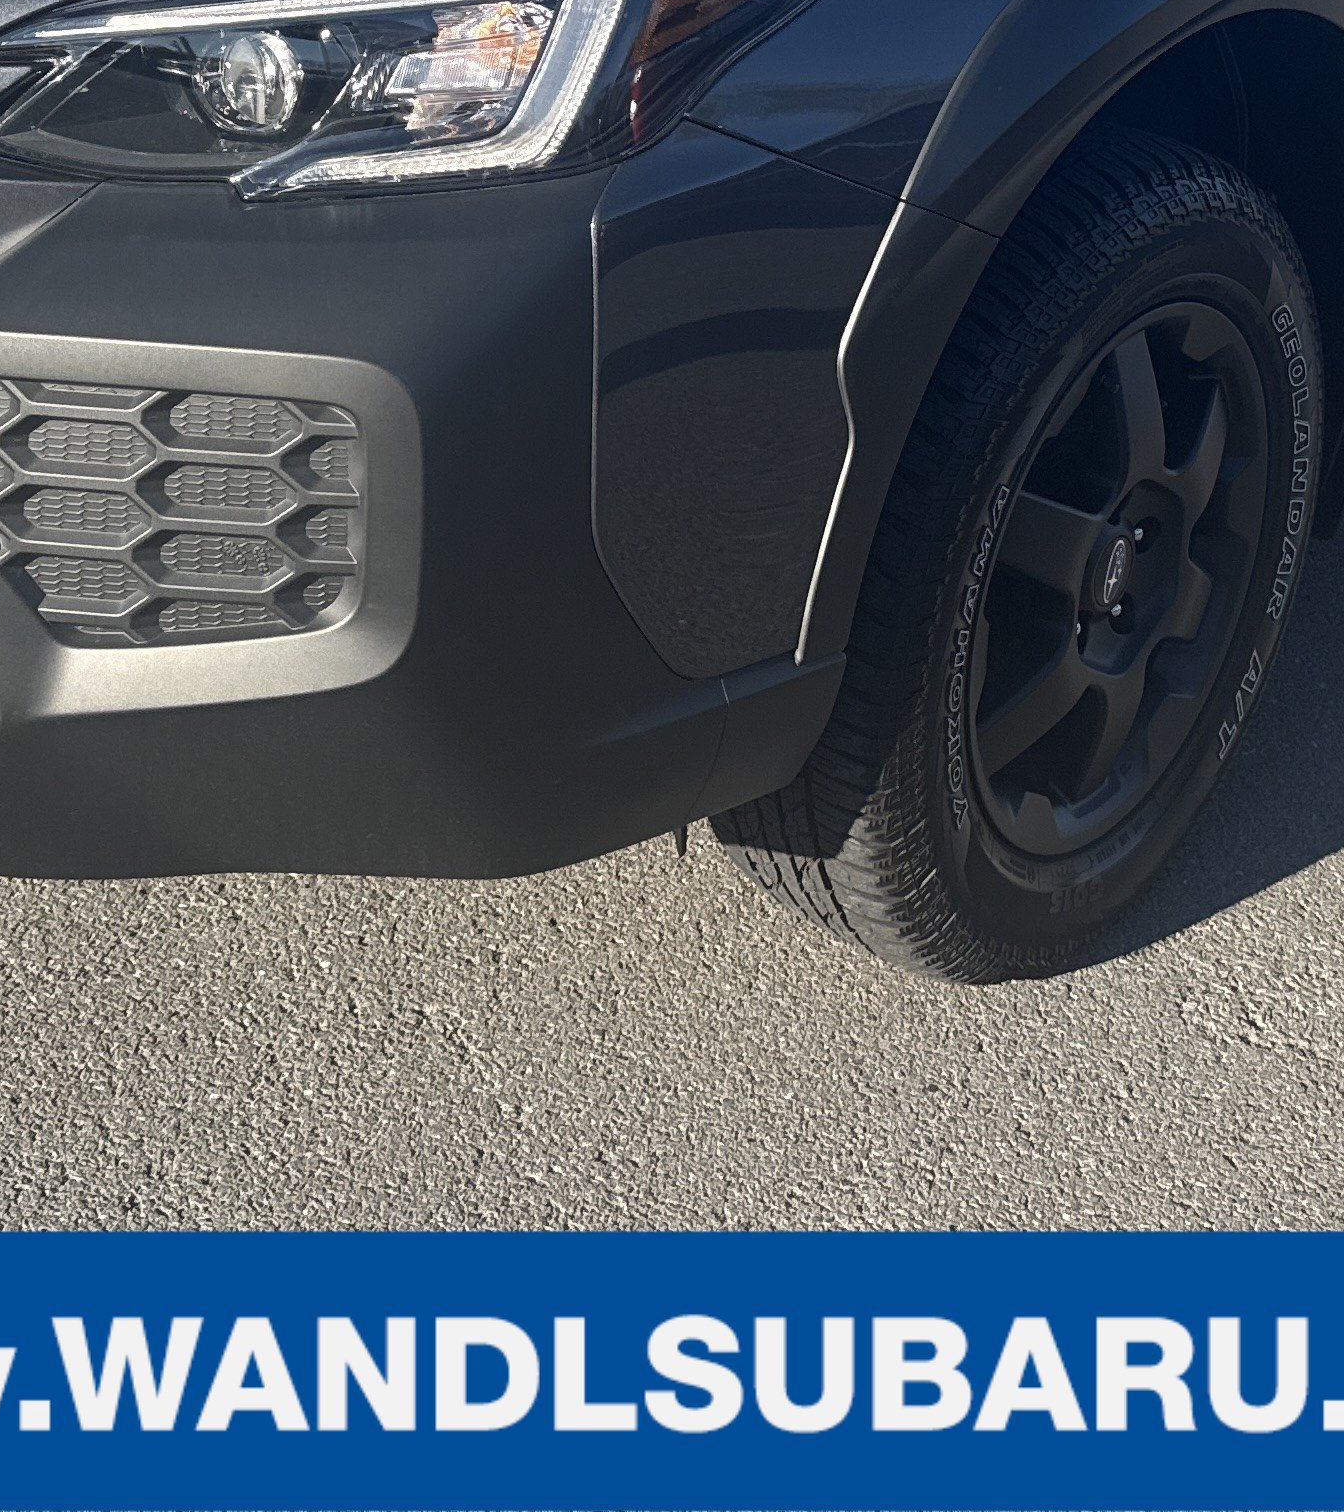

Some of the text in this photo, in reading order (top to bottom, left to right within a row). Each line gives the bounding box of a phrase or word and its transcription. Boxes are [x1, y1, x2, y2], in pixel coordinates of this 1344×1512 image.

[948, 484, 1010, 831] YOKOHAMA
[1218, 302, 1311, 761] GEOLANDAR A/T
